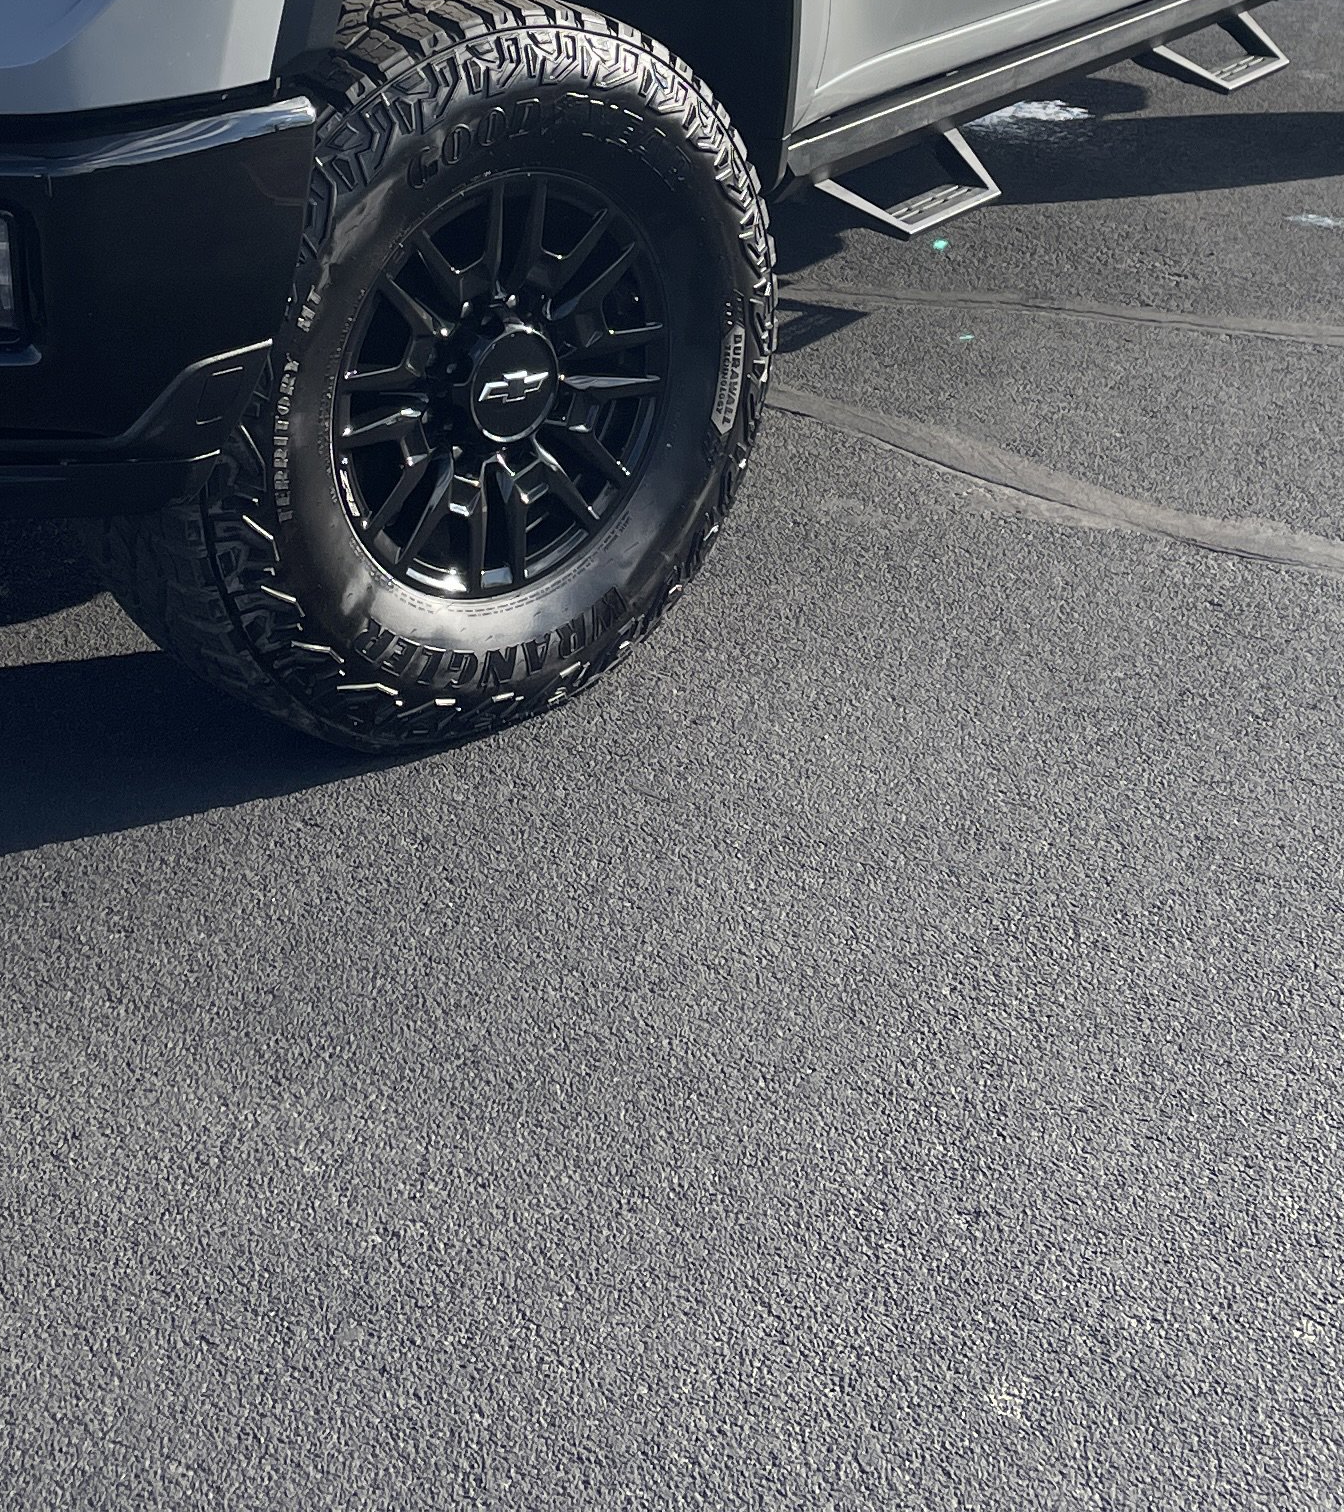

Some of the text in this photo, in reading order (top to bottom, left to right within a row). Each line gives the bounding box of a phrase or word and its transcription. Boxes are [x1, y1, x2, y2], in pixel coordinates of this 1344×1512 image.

[273, 285, 322, 523] TERRITORY MT
[715, 345, 732, 415] TECHNOLOGY
[722, 334, 743, 425] DURAWALL
[356, 585, 628, 690] WRANGLER
